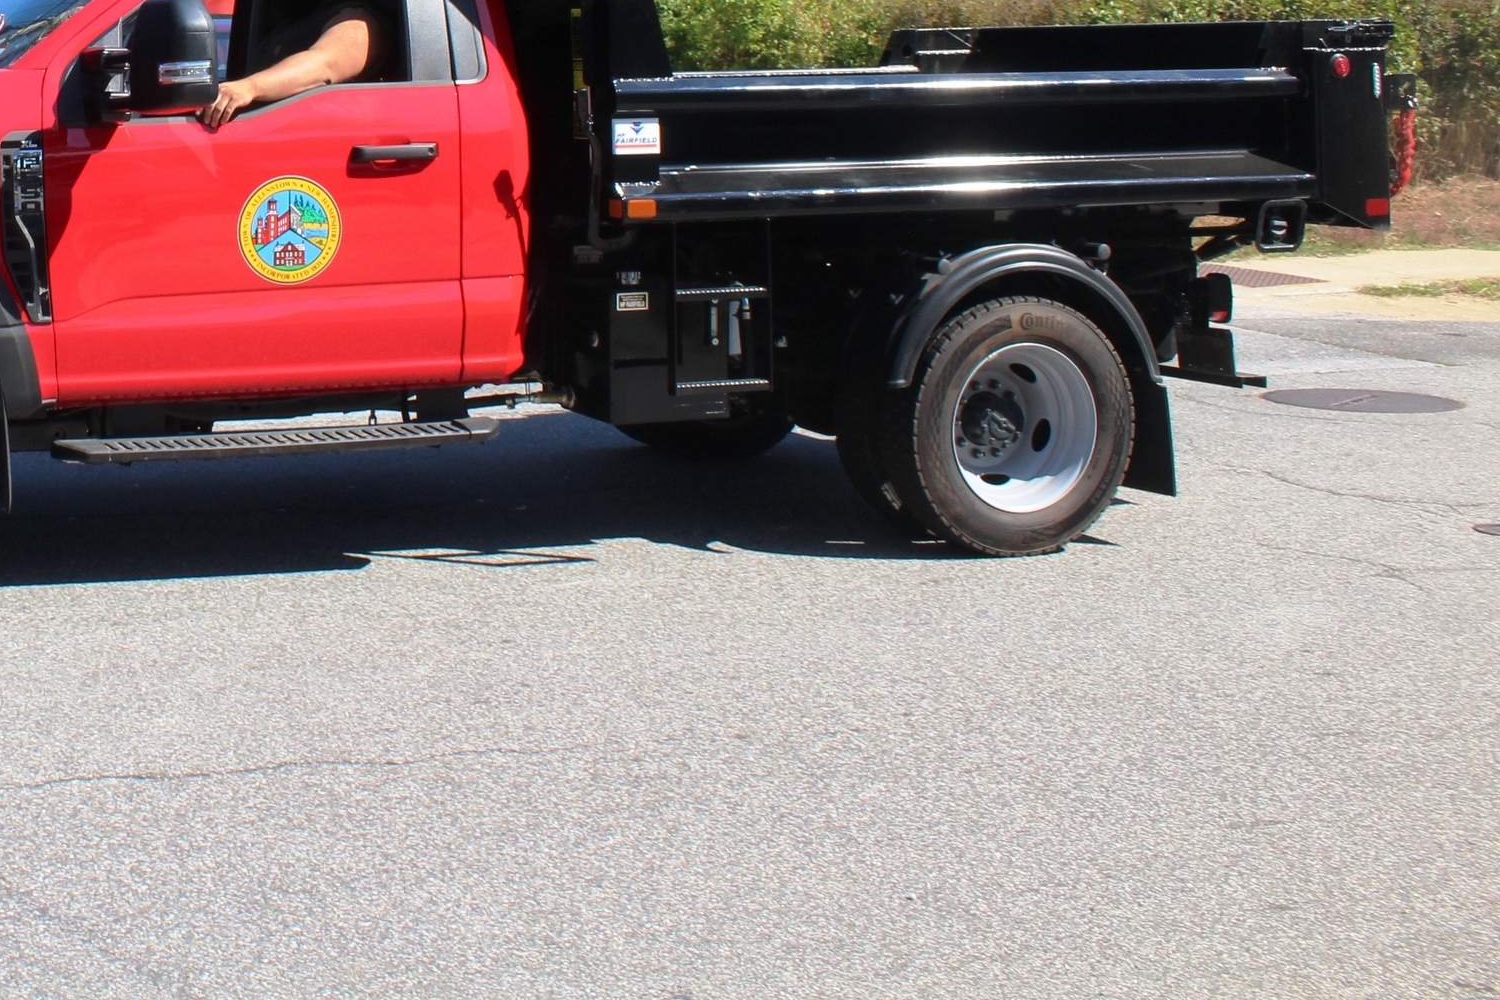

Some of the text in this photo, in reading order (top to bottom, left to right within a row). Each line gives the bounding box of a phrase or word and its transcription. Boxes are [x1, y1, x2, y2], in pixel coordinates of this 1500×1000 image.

[20, 140, 38, 148] XL
[242, 181, 338, 247] TOWN OF ALLENSTOWN NEW HAMPSHIRE
[256, 261, 310, 280] INCORPORATED
